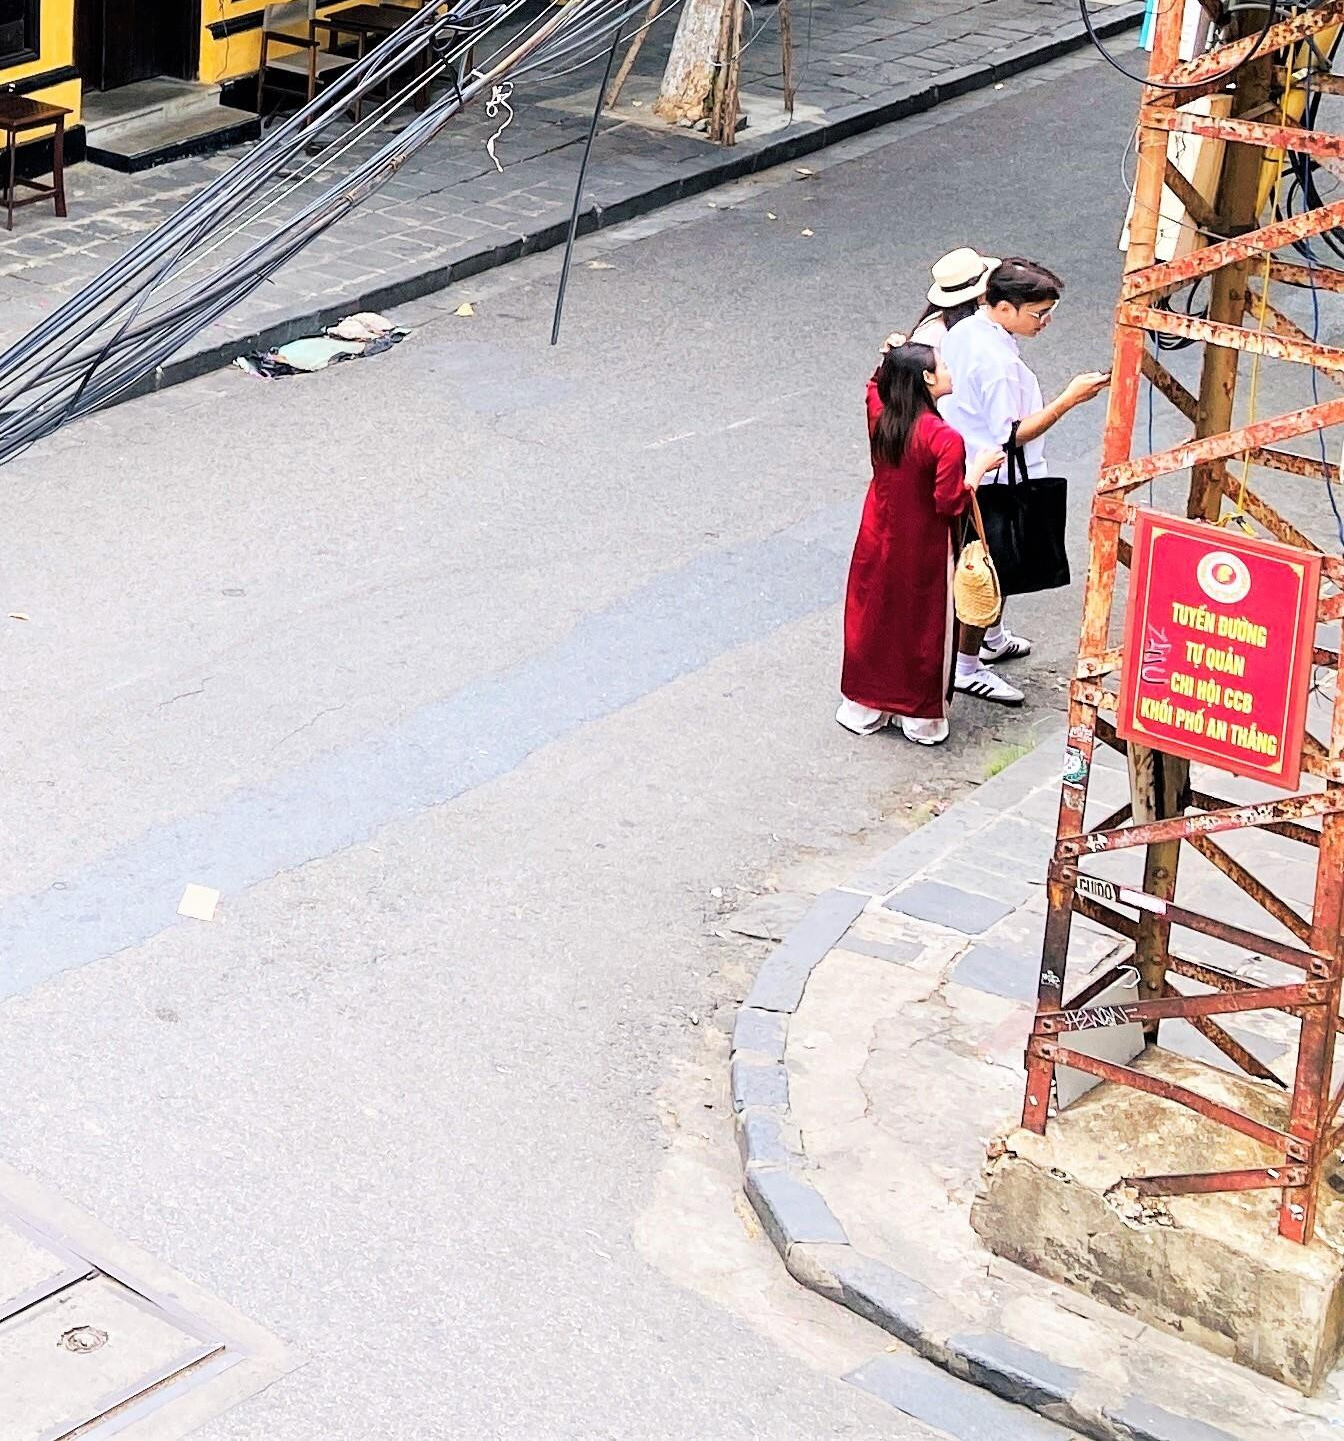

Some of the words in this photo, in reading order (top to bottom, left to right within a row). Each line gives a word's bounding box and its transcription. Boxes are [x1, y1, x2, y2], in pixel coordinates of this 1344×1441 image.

[1171, 602, 1216, 634] TUYẾN
[1217, 615, 1268, 648] ĐƯỜNG
[1185, 640, 1205, 669] TỰ
[1205, 646, 1246, 677] QUẢN
[1170, 671, 1194, 697] CHI
[1196, 678, 1221, 708] HỘI
[1223, 687, 1253, 714] CCB
[1140, 696, 1174, 725] KHỐI
[1175, 707, 1206, 735] PHỐ
[1206, 717, 1228, 742] AN
[1230, 722, 1278, 757] THẮNG
